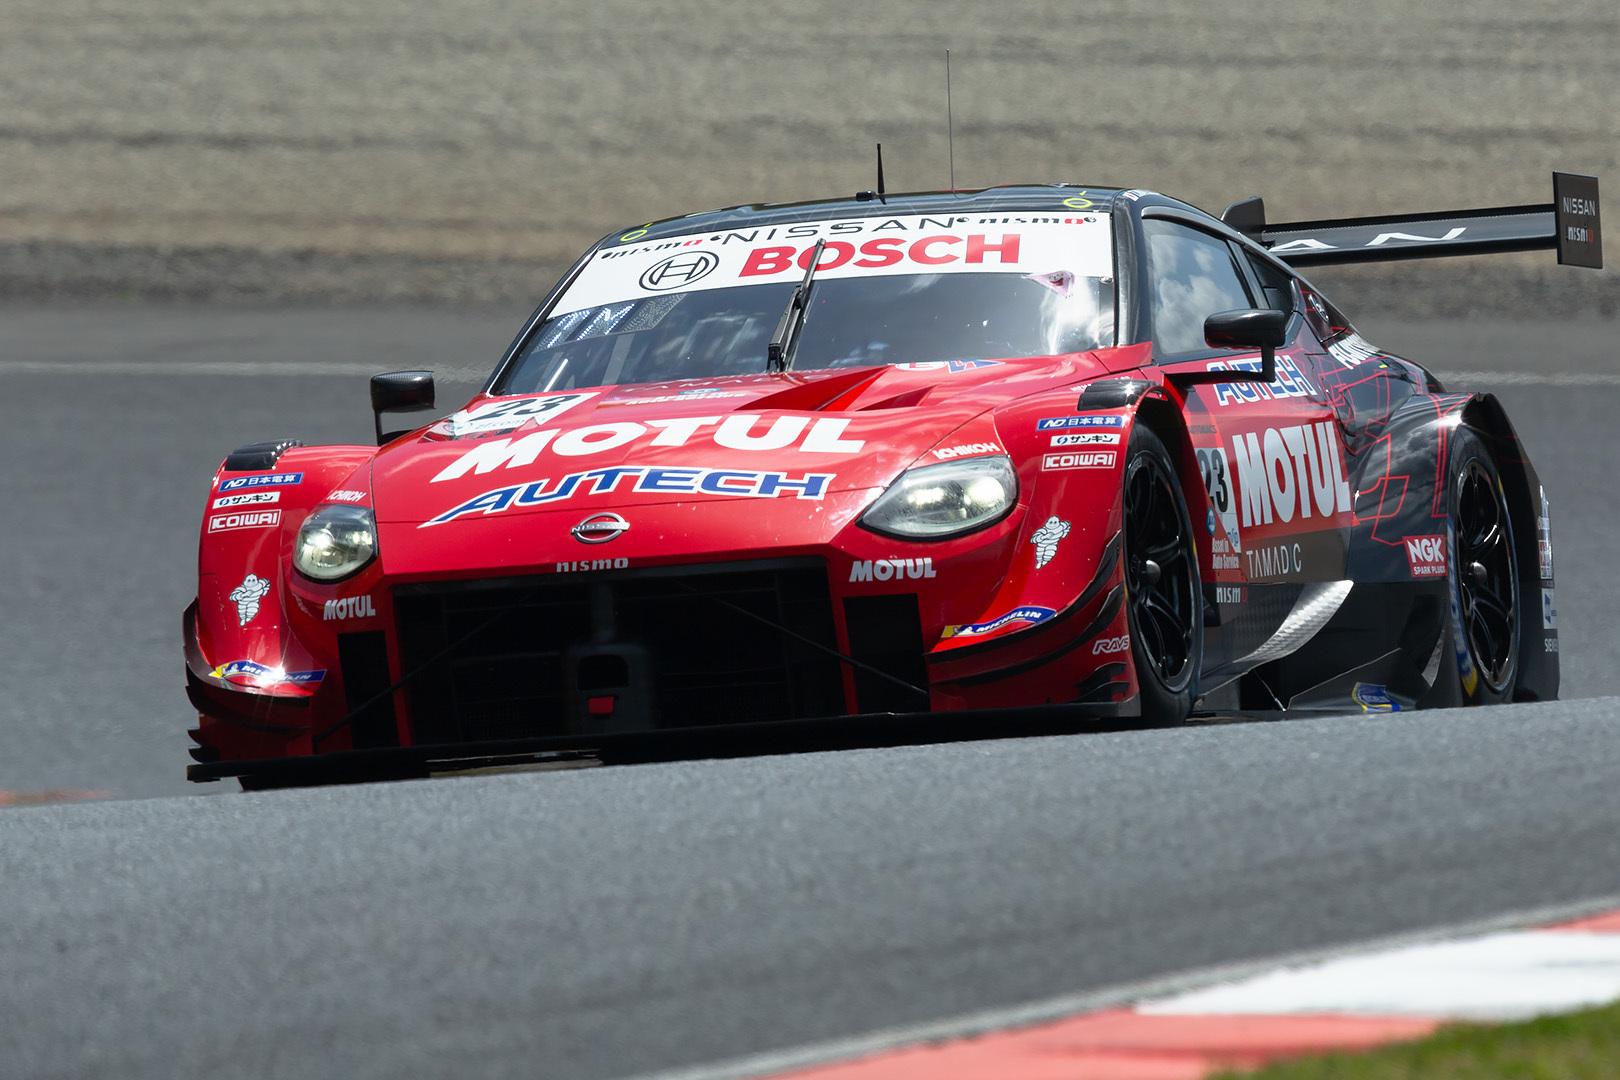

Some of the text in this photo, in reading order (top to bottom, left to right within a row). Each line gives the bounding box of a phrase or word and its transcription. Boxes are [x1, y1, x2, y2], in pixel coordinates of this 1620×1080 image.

[1563, 197, 1595, 216] NISSAN
[721, 215, 955, 246] NISSAN
[978, 217, 1084, 226] nismo
[1567, 226, 1594, 243] nismo
[738, 233, 1021, 278] BOSCH
[467, 394, 581, 422] 23
[1068, 416, 1117, 427] 日本電算
[430, 414, 867, 483] MOTUL
[1070, 435, 1114, 444] サンキン
[933, 442, 1001, 460] ICHIKOH
[1045, 453, 1114, 469] KOIWAI
[248, 474, 296, 487] 日本電算
[1232, 420, 1351, 528] MOTUL
[232, 493, 274, 504] サンキン
[326, 489, 367, 503] ICHIKOH
[417, 465, 837, 529] AUTECH
[211, 512, 278, 530] KOIWAI
[1406, 537, 1445, 563] NGK
[556, 557, 629, 574] nismo
[849, 557, 937, 582] MOTUL
[1246, 543, 1302, 579] TAMADIC
[1413, 565, 1446, 575] SPARK PLUGS
[1216, 586, 1248, 603] nismo
[323, 594, 376, 621] MOTUL
[976, 610, 1043, 634] MICHELIN
[1092, 633, 1130, 655] RAYS
